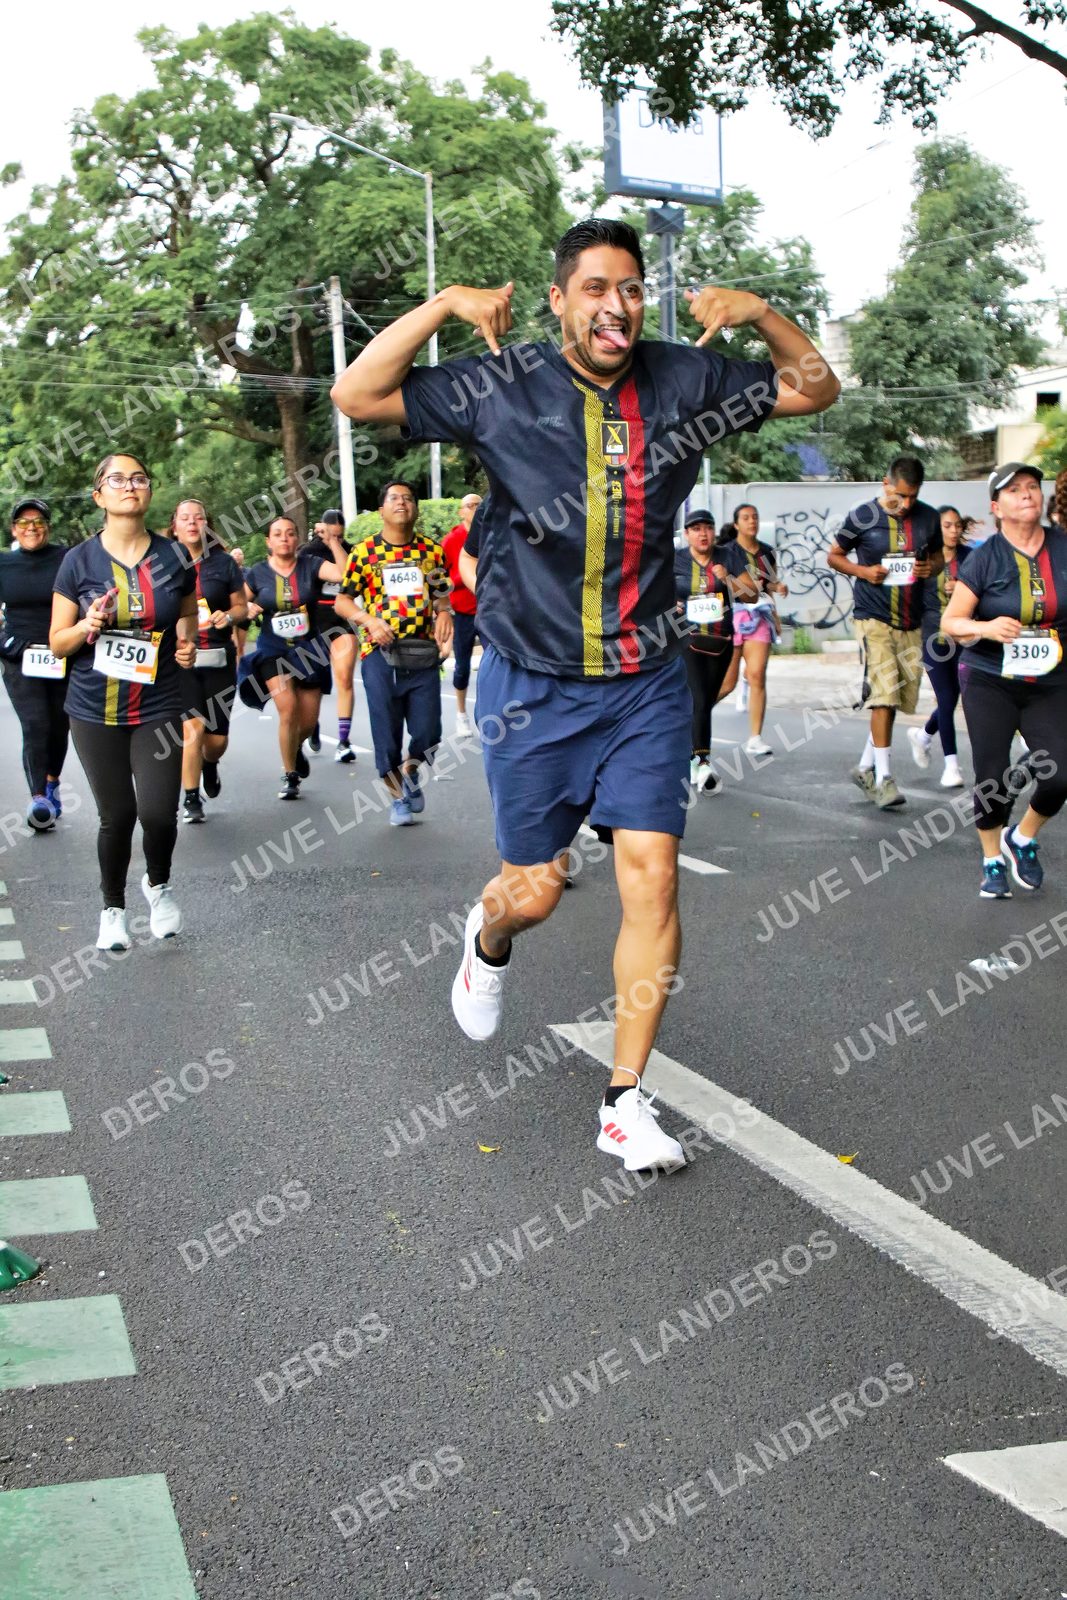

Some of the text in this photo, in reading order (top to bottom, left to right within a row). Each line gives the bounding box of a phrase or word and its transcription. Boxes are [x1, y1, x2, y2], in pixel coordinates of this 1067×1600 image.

[889, 562, 914, 573] 4067
[390, 572, 418, 584] 4648
[278, 617, 303, 630] 3501
[105, 640, 147, 664] 1550
[1011, 644, 1050, 659] 3309
[30, 653, 56, 665] 1163
